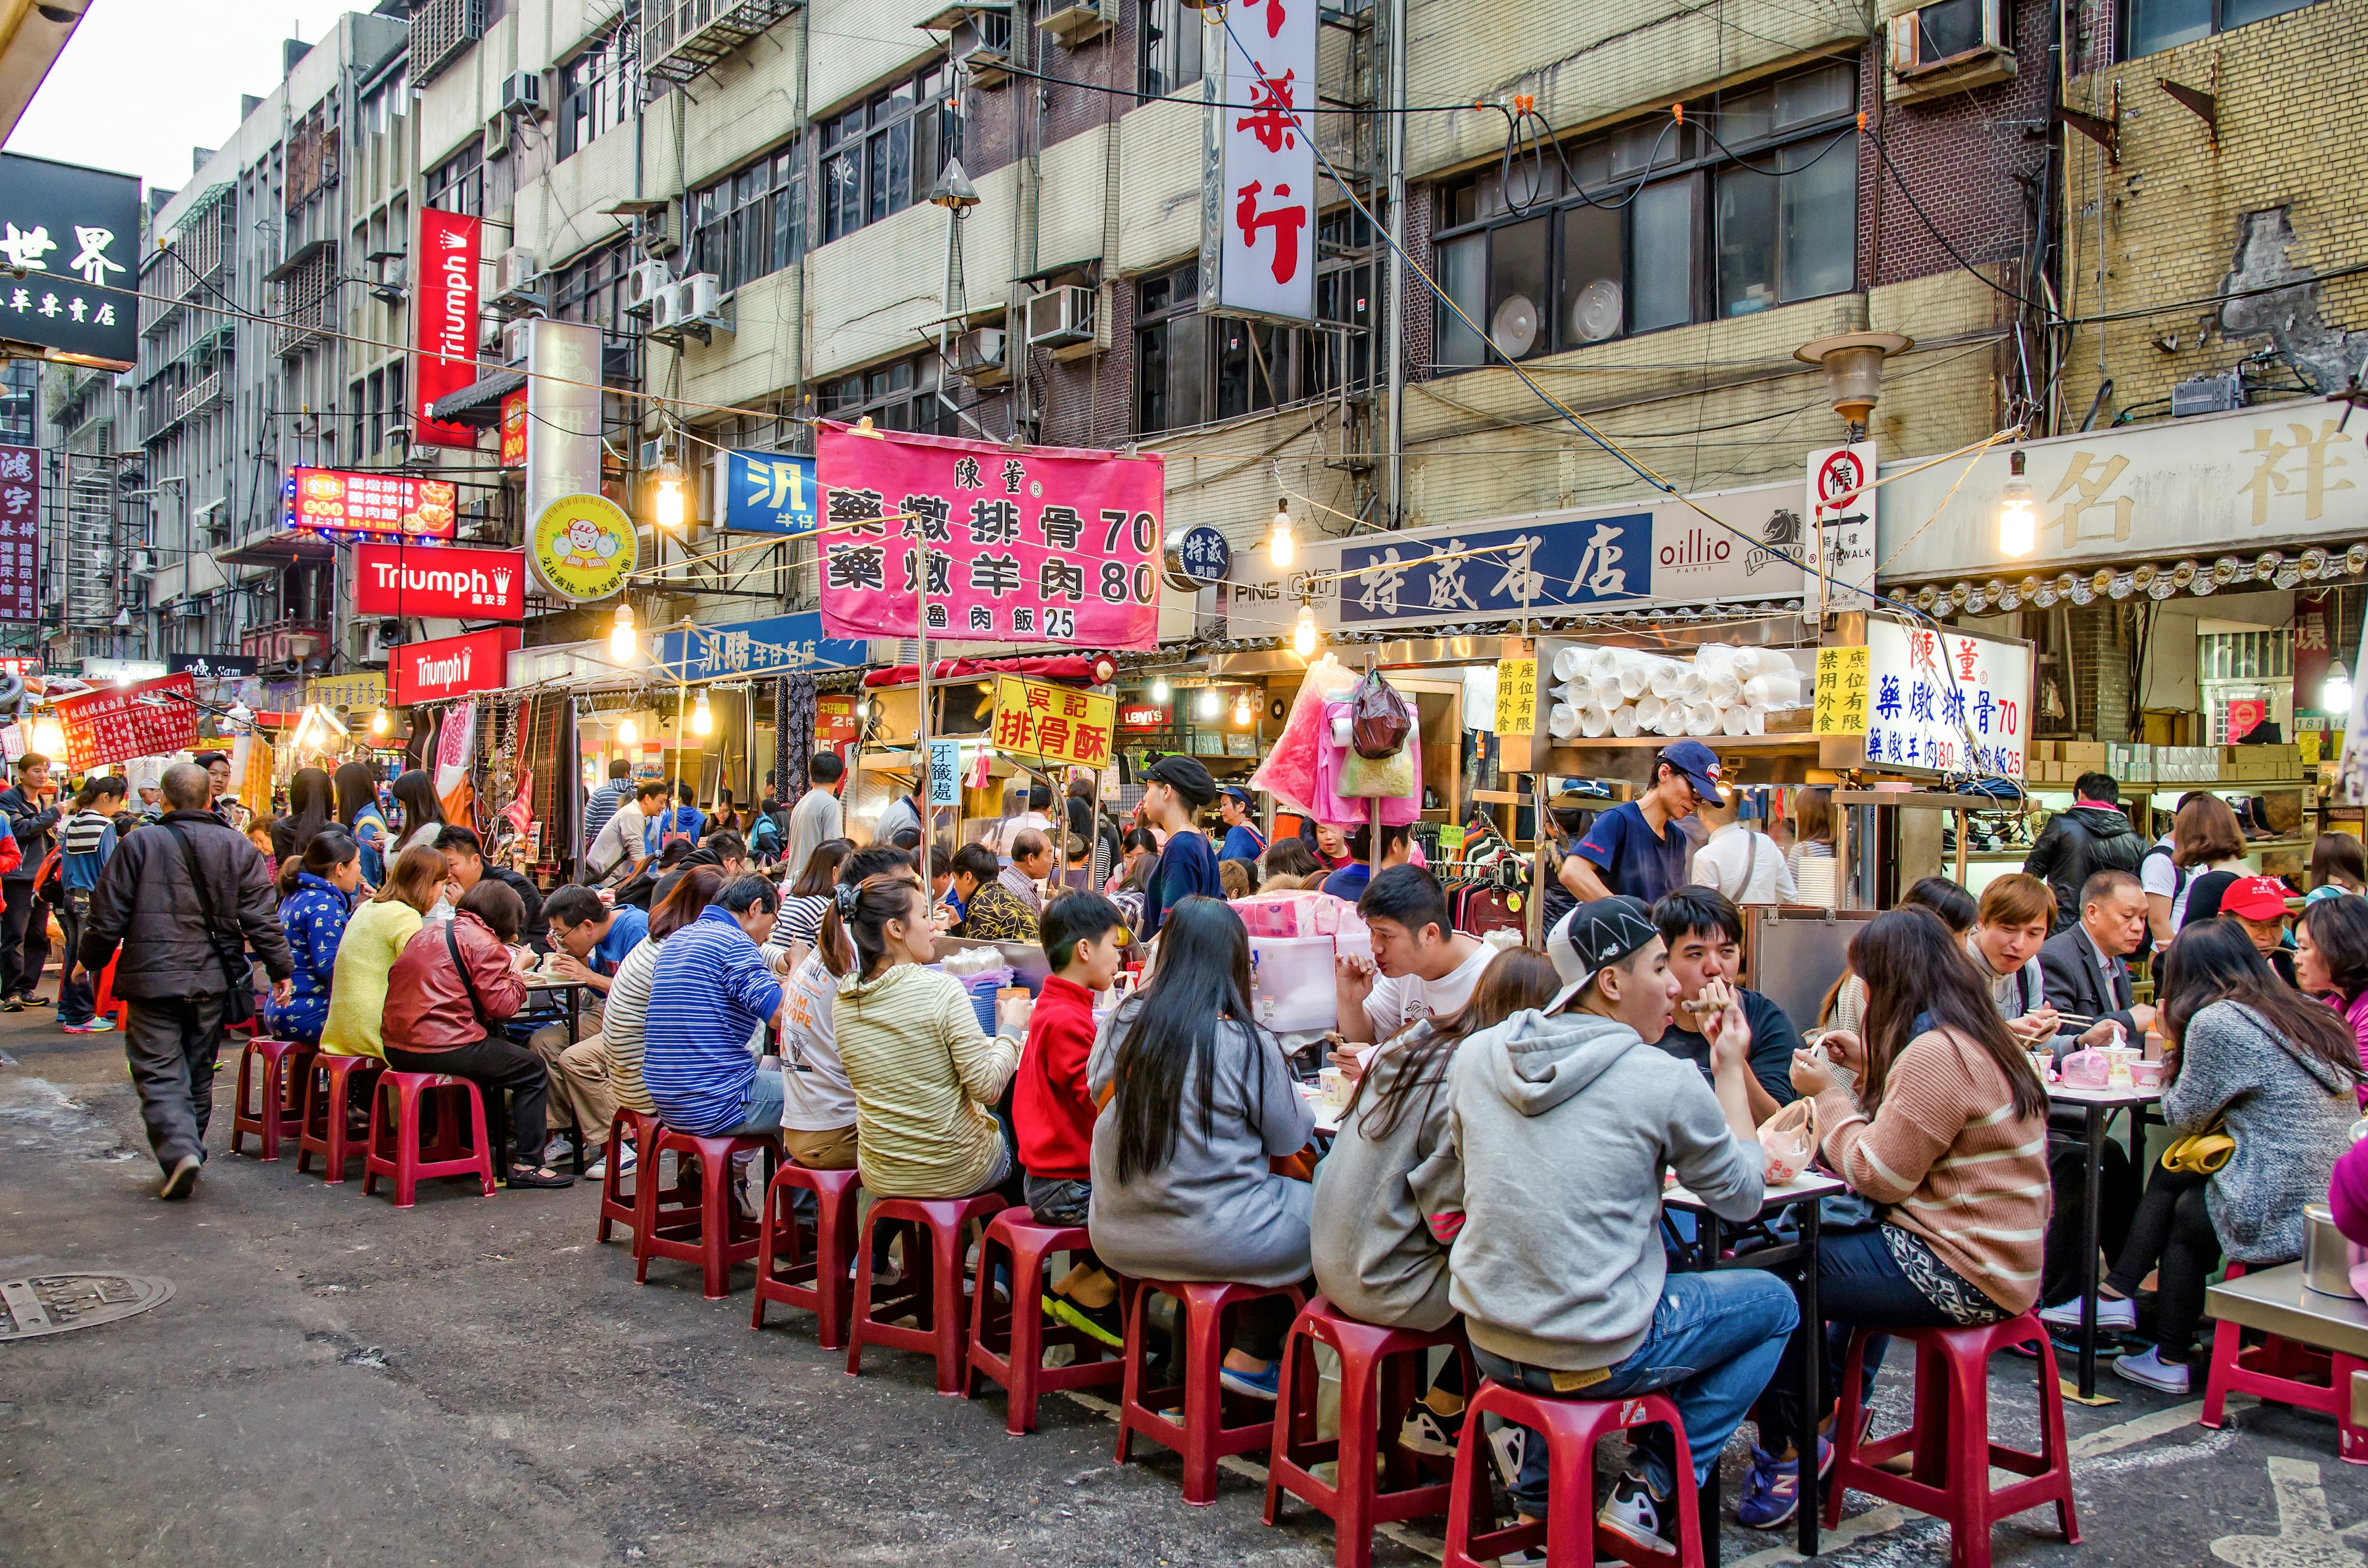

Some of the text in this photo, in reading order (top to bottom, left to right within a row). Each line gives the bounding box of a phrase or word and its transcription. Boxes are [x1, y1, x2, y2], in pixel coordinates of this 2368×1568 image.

[0, 221, 126, 286] 世界
[0, 288, 116, 326] 革專賣店
[438, 253, 472, 367] Triumph
[307, 478, 341, 495] 金林
[348, 477, 414, 495] 藥燉排骨
[954, 455, 1026, 496] 陳董
[348, 491, 414, 509] 藥燉羊肉
[348, 504, 398, 520] 魯肉飯
[775, 512, 815, 529] 牛仔
[825, 487, 1159, 555] 藥燉排骨 70
[565, 554, 608, 568] Abby Ruby
[1659, 528, 1730, 565] oillio
[371, 562, 488, 599] Triumph
[826, 541, 1159, 606] 藥燉羊肉 80
[1194, 565, 1218, 578] 男飾
[1677, 565, 1712, 574] PARIS
[472, 593, 508, 606] 黛安芬
[1235, 581, 1280, 603] PING
[1235, 601, 1280, 609] COLLECTION
[926, 602, 1074, 638] 魯肉飯 25
[416, 652, 461, 691] Triumph
[1910, 631, 1979, 682] 陳董
[1027, 687, 1088, 719] 吳記
[1497, 662, 1513, 733] 禁用外食
[1516, 662, 1535, 731] 座位有限
[1815, 650, 1838, 732] 禁用外食
[1842, 651, 1866, 731] 座位有限
[1876, 674, 2017, 736] 藥燉排骨 70
[998, 708, 1107, 761] 排骨酥
[2297, 719, 2324, 729] 181
[1867, 726, 1938, 770] 藥燉羊肉
[1938, 741, 1954, 768] 80
[2007, 750, 2021, 775] 25
[931, 743, 953, 802] 牙籤處
